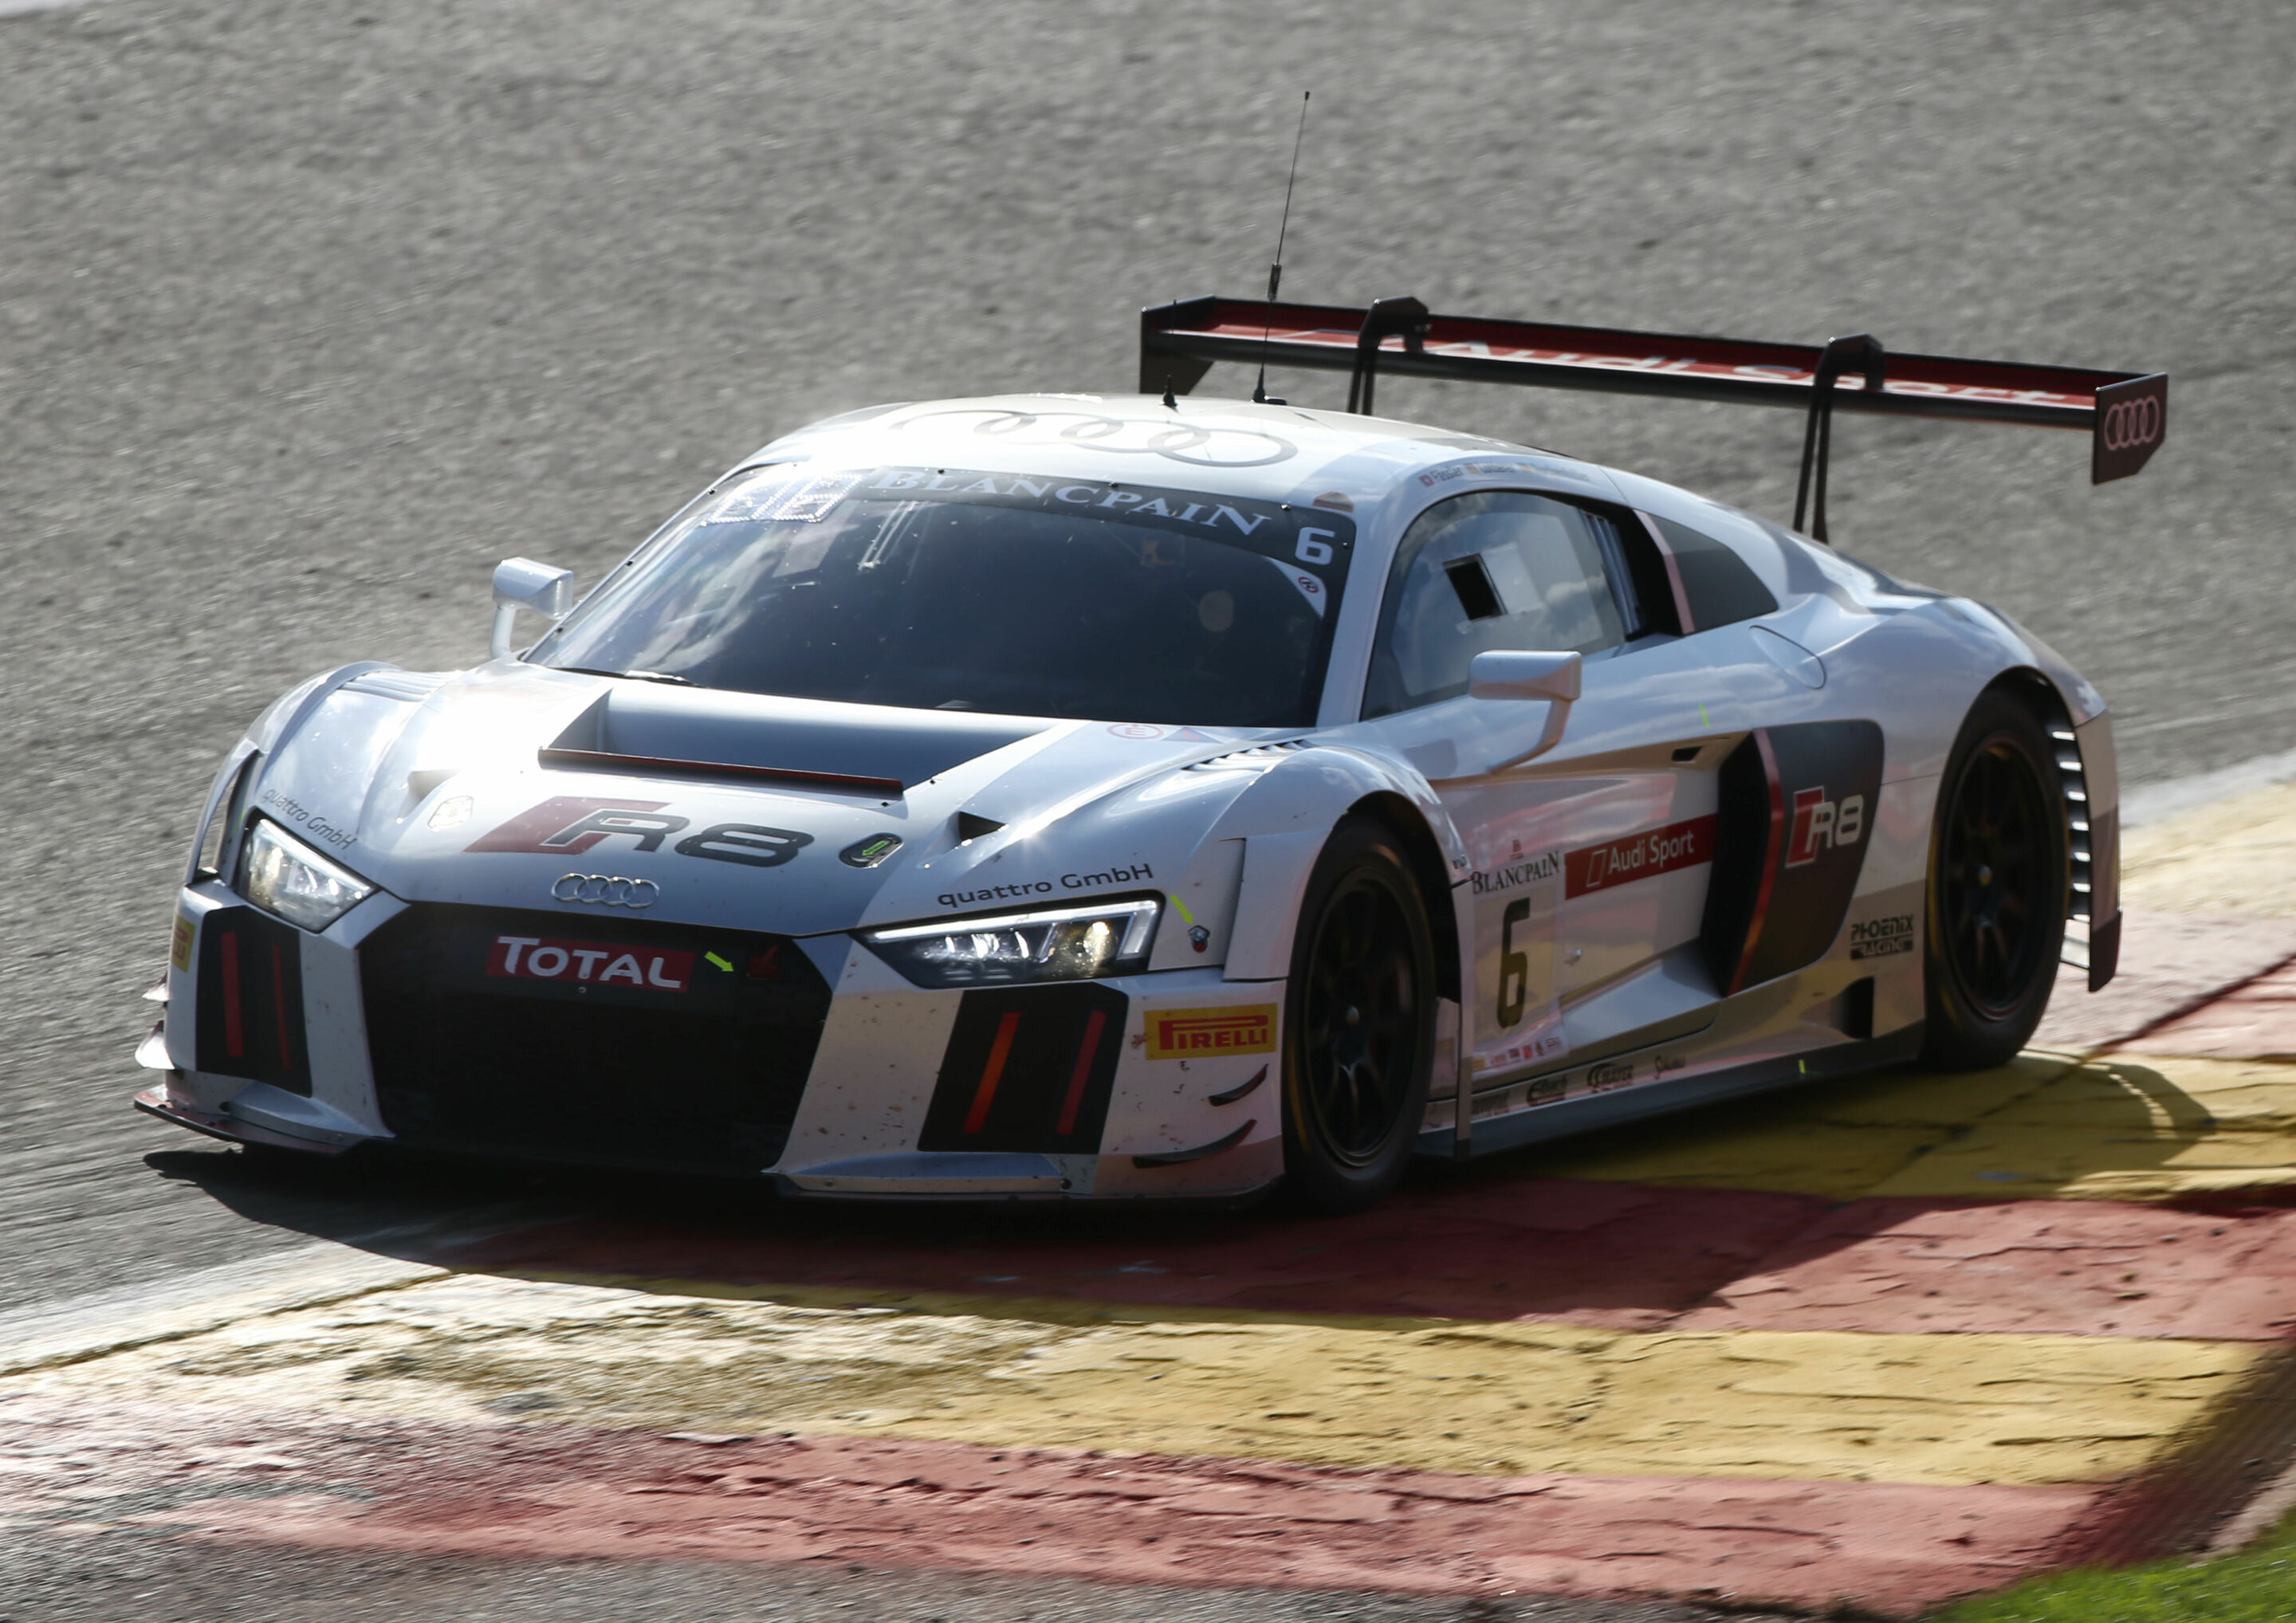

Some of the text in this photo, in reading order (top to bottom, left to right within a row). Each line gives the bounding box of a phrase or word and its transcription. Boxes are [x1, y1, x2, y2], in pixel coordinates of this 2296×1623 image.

[869, 470, 1272, 536] BLANCPAIN
[1295, 526, 1336, 565] 6
[263, 788, 358, 850] quattro GmbH
[531, 807, 815, 867] R8
[1800, 792, 1865, 856] R8
[1471, 851, 1560, 894] BLANCPAIN
[1608, 830, 1694, 874] Audi Sport
[937, 863, 1154, 908] quattro GmbH
[497, 935, 682, 989] TOTAL
[1496, 897, 1531, 1029] 6
[1158, 1015, 1268, 1051] PIRELLI
